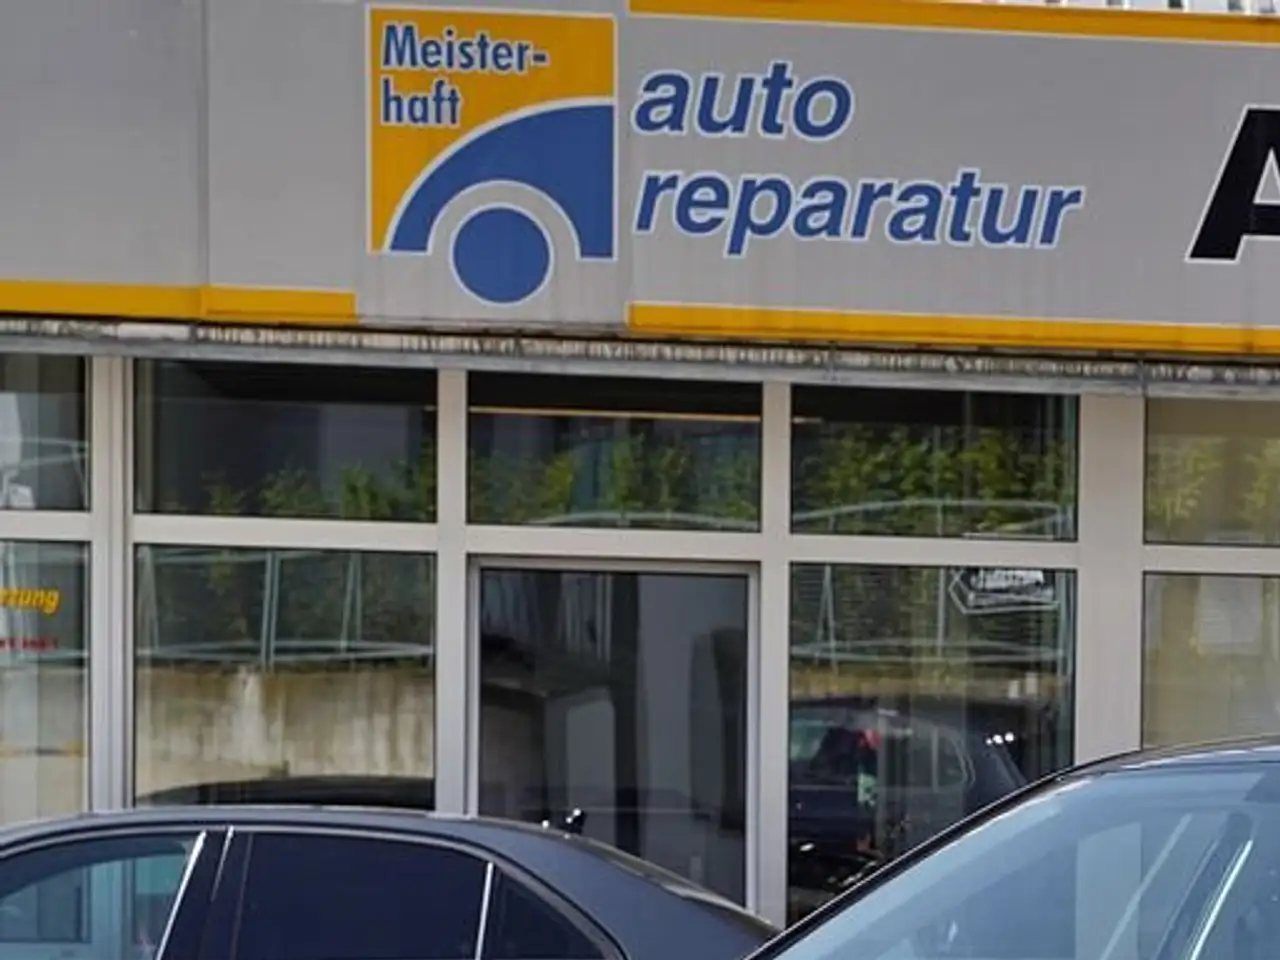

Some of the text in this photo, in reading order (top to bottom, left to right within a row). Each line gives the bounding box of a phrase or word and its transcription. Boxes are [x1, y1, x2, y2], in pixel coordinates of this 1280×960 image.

[382, 23, 547, 72] Meister-
[382, 76, 460, 125] haft
[635, 62, 853, 139] auto
[636, 169, 1083, 257] reparatur
